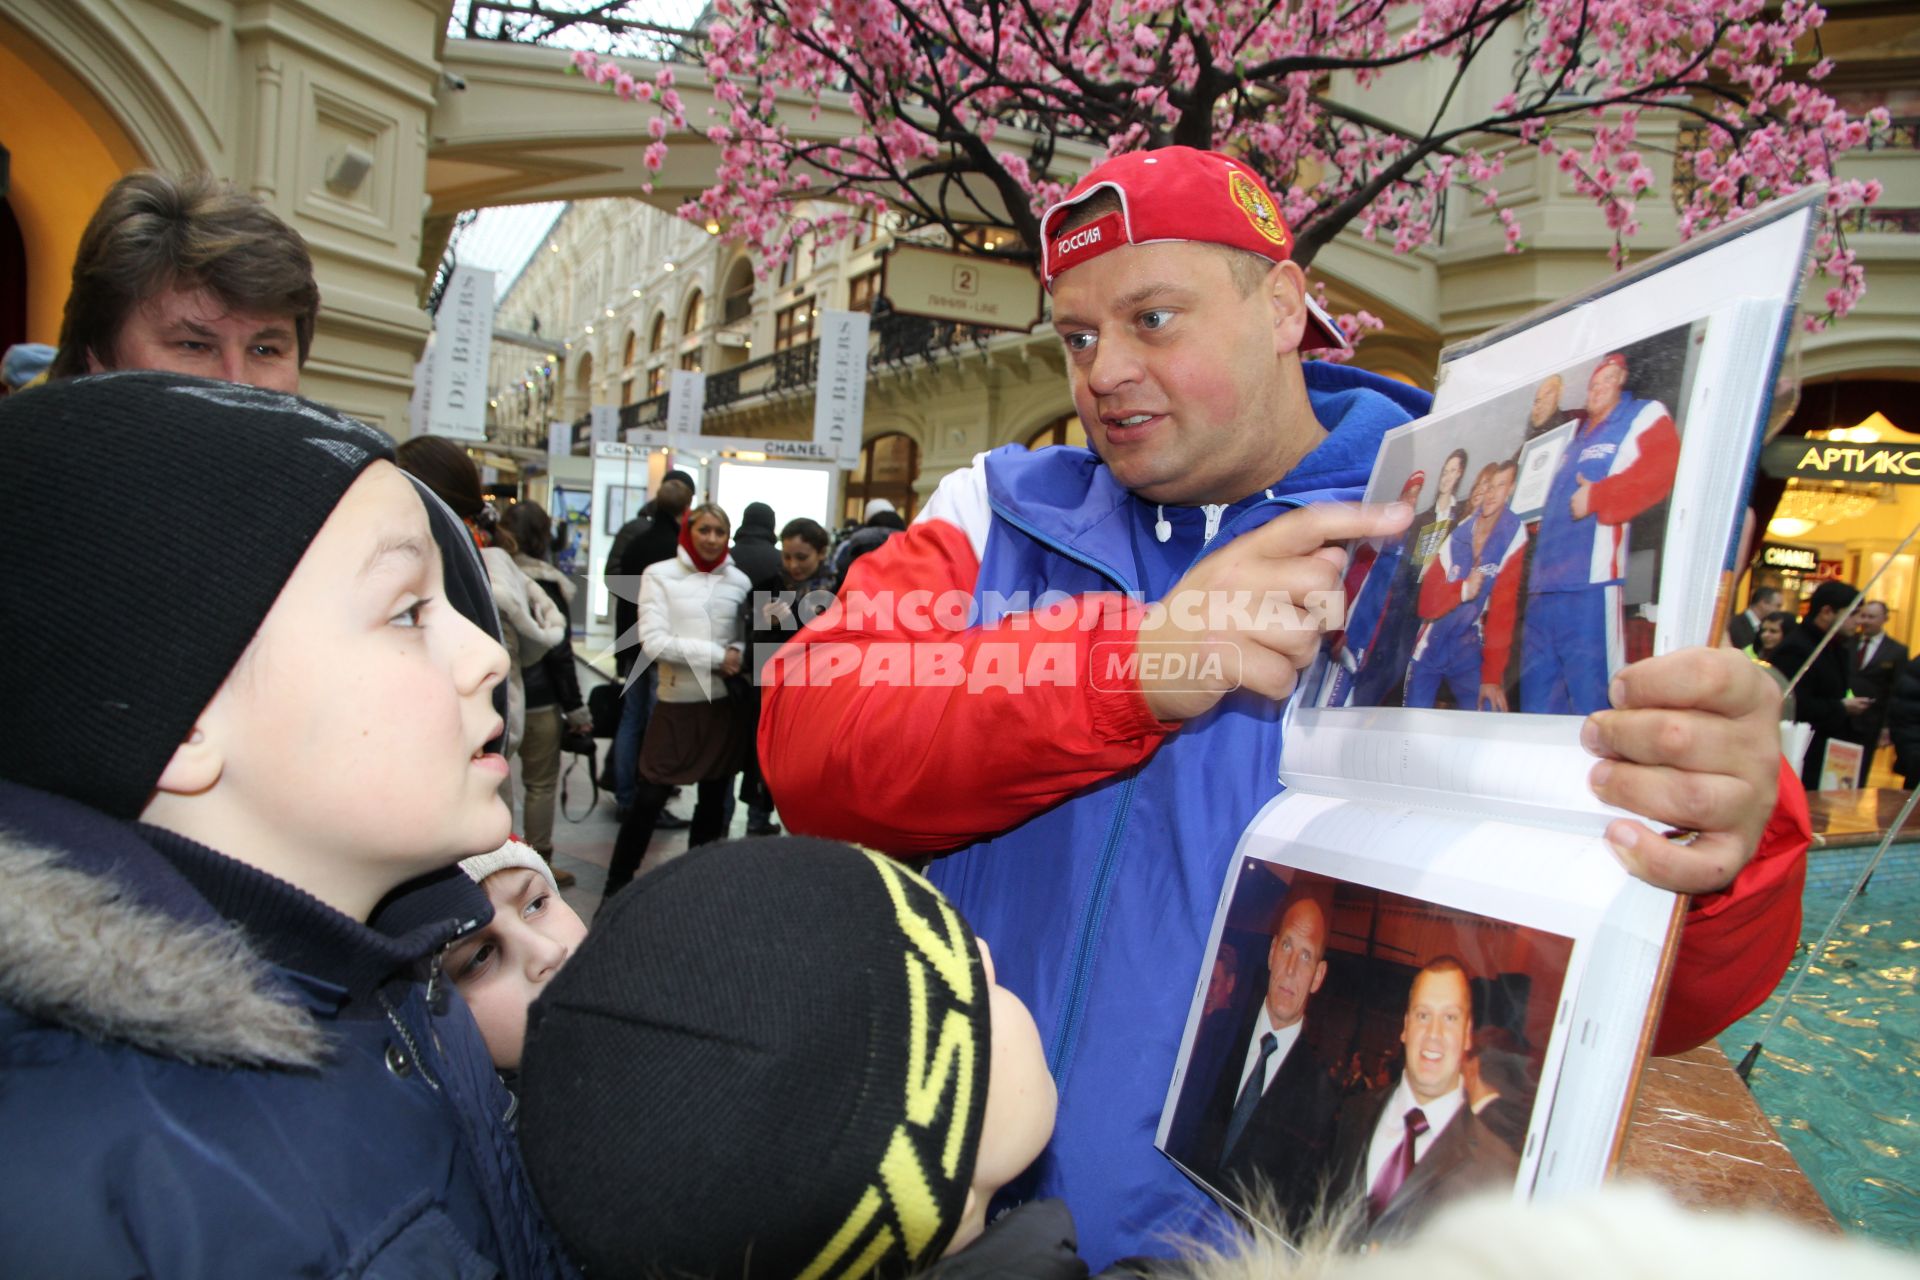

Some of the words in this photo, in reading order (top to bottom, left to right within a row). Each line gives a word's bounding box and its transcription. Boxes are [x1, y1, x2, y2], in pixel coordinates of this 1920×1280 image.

[1058, 226, 1101, 257] РОССИЯ
[960, 271, 972, 290] 2
[451, 274, 476, 364] BEERS
[832, 321, 851, 400] BEERS
[764, 441, 827, 456] CHANEL
[1764, 547, 1817, 570] CHANEL
